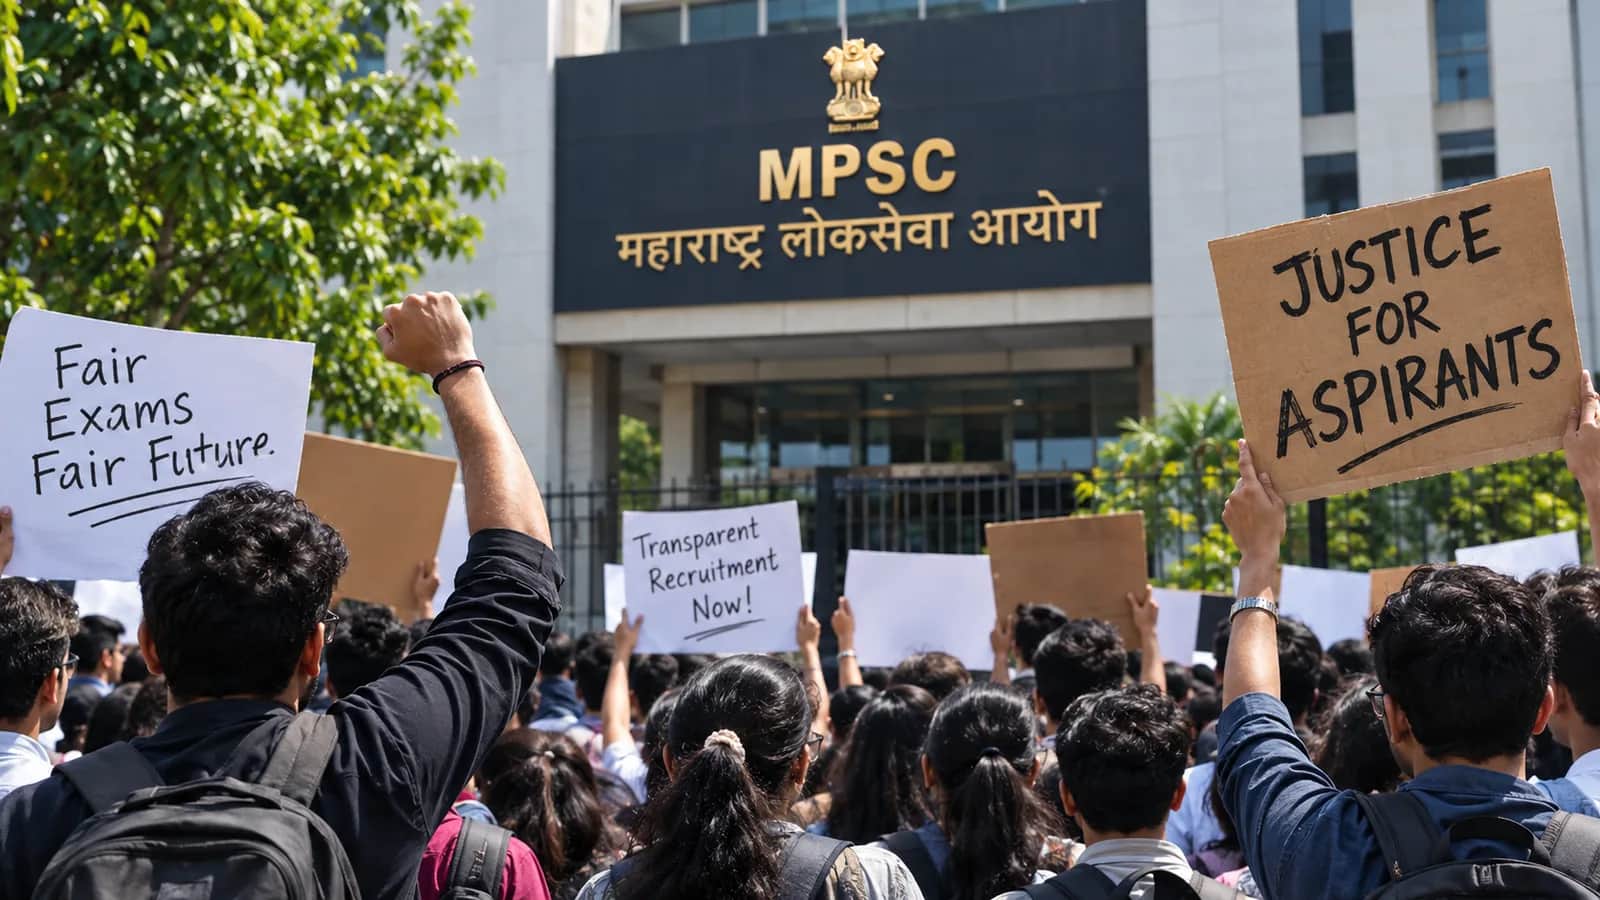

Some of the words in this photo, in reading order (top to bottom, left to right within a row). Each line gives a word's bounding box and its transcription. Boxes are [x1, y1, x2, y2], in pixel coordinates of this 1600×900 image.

[759, 138, 956, 201] MPSC
[616, 225, 765, 270] महाराष्ट्र
[779, 201, 954, 259] लोकसेवा
[969, 190, 1103, 246] आयोग
[1273, 203, 1502, 318] JUSTICE
[1345, 290, 1441, 357] FOR
[54, 343, 148, 390] Fair
[1276, 317, 1561, 459] ASPIRANTS
[44, 392, 194, 442] Exams
[32, 450, 126, 496] Fair
[148, 431, 275, 482] Future.
[632, 517, 759, 560] Transparent
[648, 548, 779, 594] Recruitment
[692, 585, 752, 623] Now!
